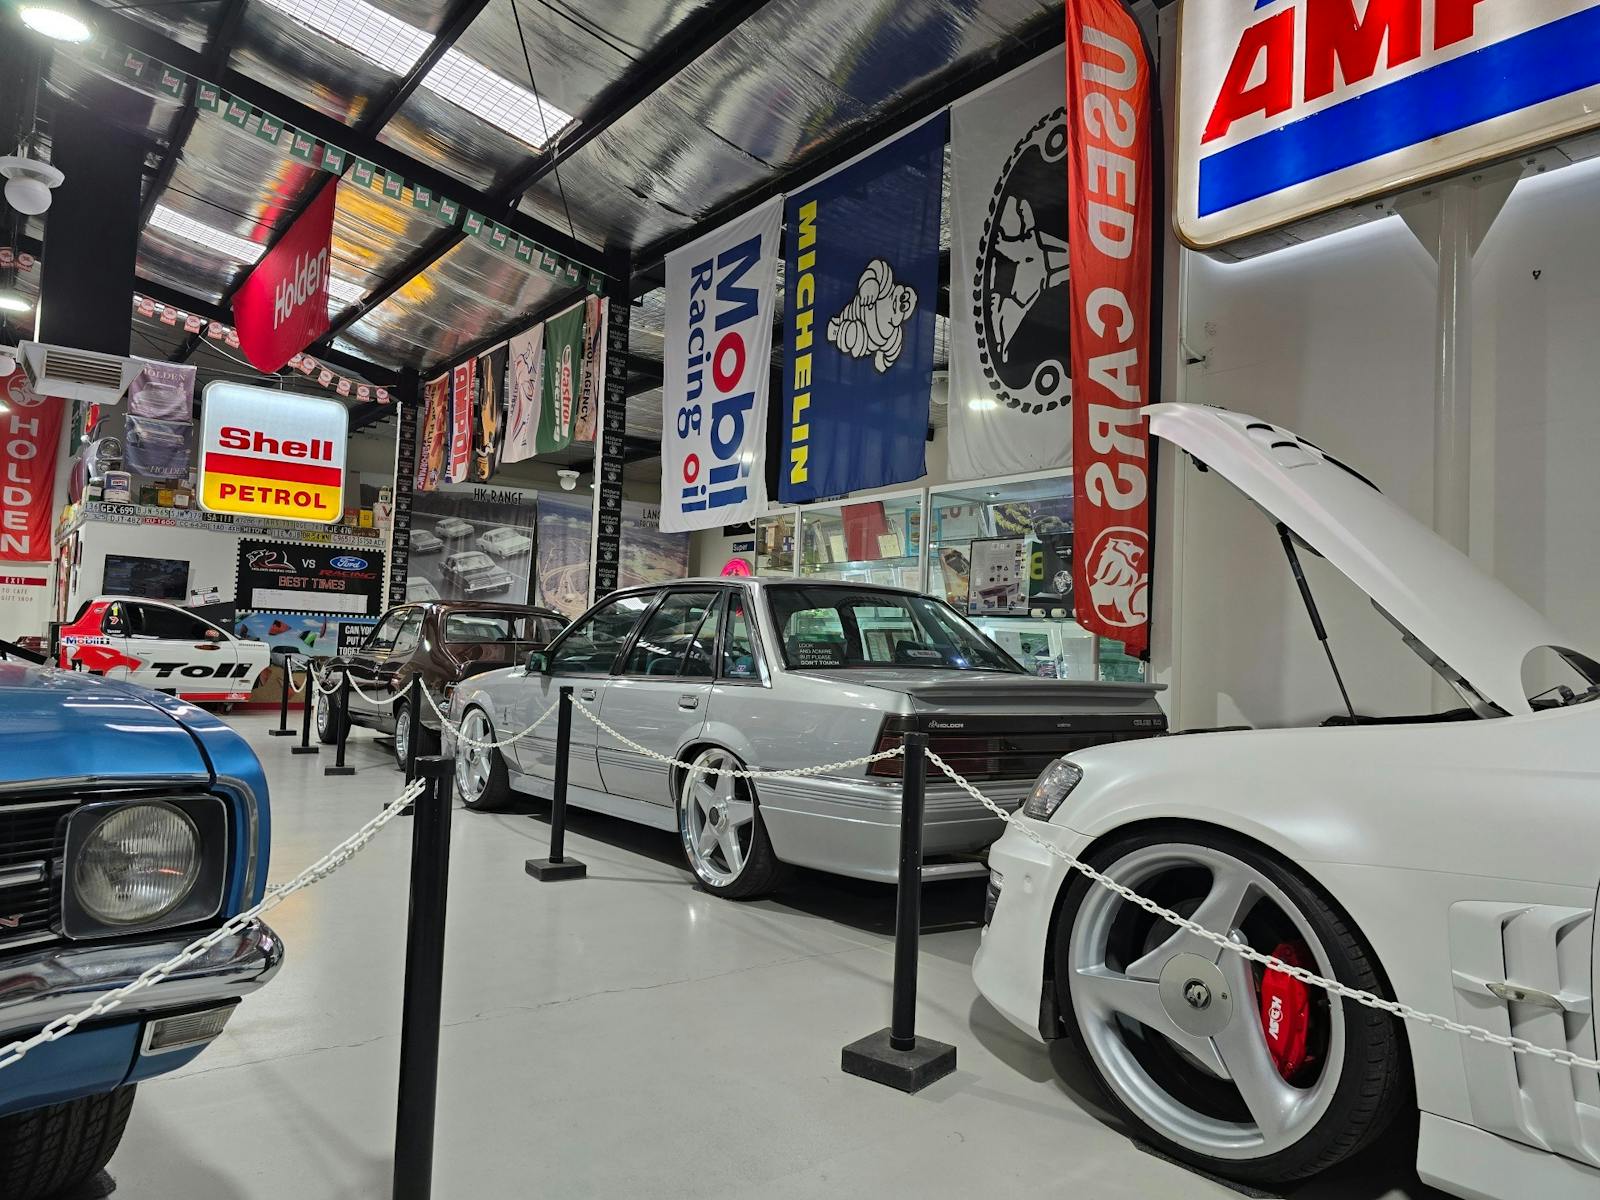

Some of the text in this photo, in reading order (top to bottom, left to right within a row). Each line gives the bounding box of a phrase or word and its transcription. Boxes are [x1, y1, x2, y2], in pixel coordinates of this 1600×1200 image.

[273, 248, 328, 330] Holden
[790, 199, 817, 485] MICHELIN
[708, 233, 762, 509] Mobil
[677, 258, 713, 513] Racing oil
[218, 426, 333, 461] Shell
[0, 415, 39, 554] HOLDEN
[220, 483, 327, 509] PETROL
[474, 488, 524, 505] HK RANGE
[338, 560, 360, 568] Ford
[278, 576, 346, 590] BEST TIMES
[345, 625, 360, 634] CAN
[66, 636, 99, 645] Mobil
[346, 636, 359, 646] PUT
[151, 662, 253, 678] Toll
